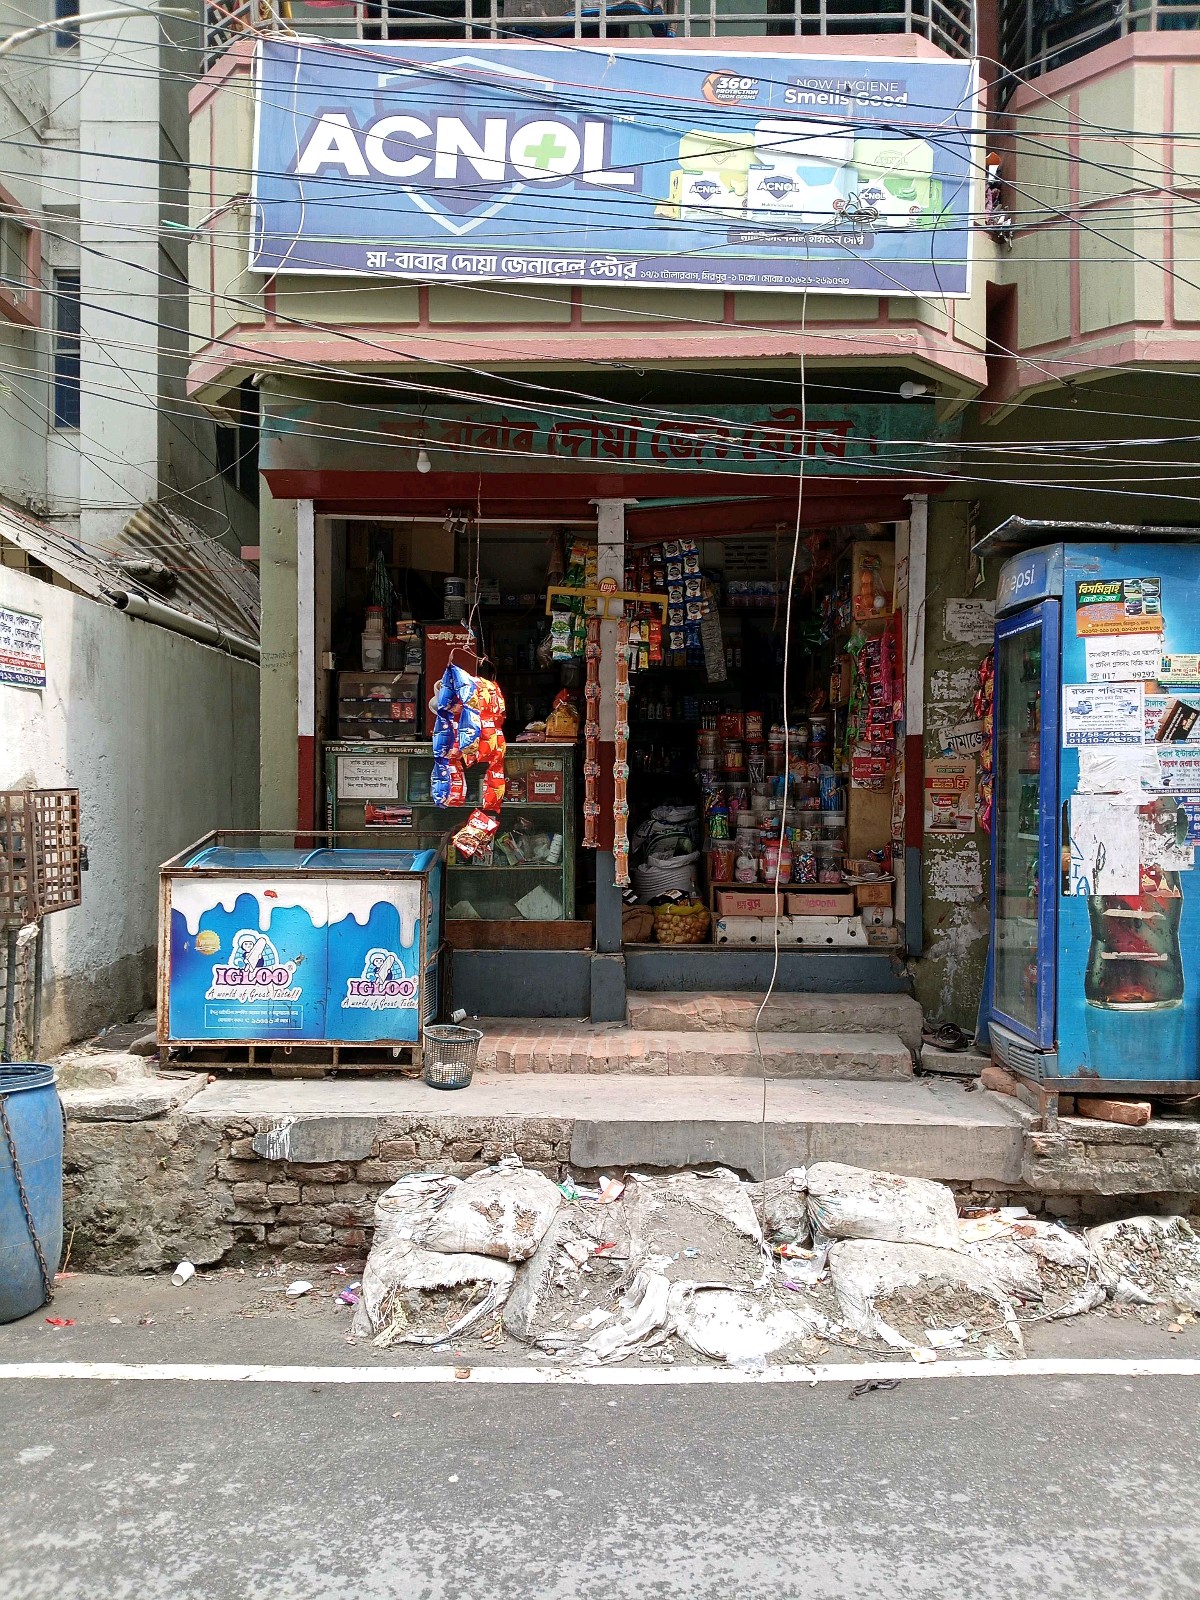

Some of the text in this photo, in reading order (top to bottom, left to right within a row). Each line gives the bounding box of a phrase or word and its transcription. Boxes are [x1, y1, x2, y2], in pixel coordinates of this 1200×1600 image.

[797, 78, 899, 92] NOW HYGIENE
[784, 89, 908, 108] Smells Good
[295, 113, 634, 185] ACNOL
[689, 184, 721, 194] ACNOL
[757, 181, 800, 192] ACNOL
[366, 251, 637, 278] মা-বাবার দোয়া জেনারেল স্টোর
[600, 583, 617, 593] Lay's
[216, 968, 289, 986] IGLOO
[350, 981, 414, 996] IGLOO
